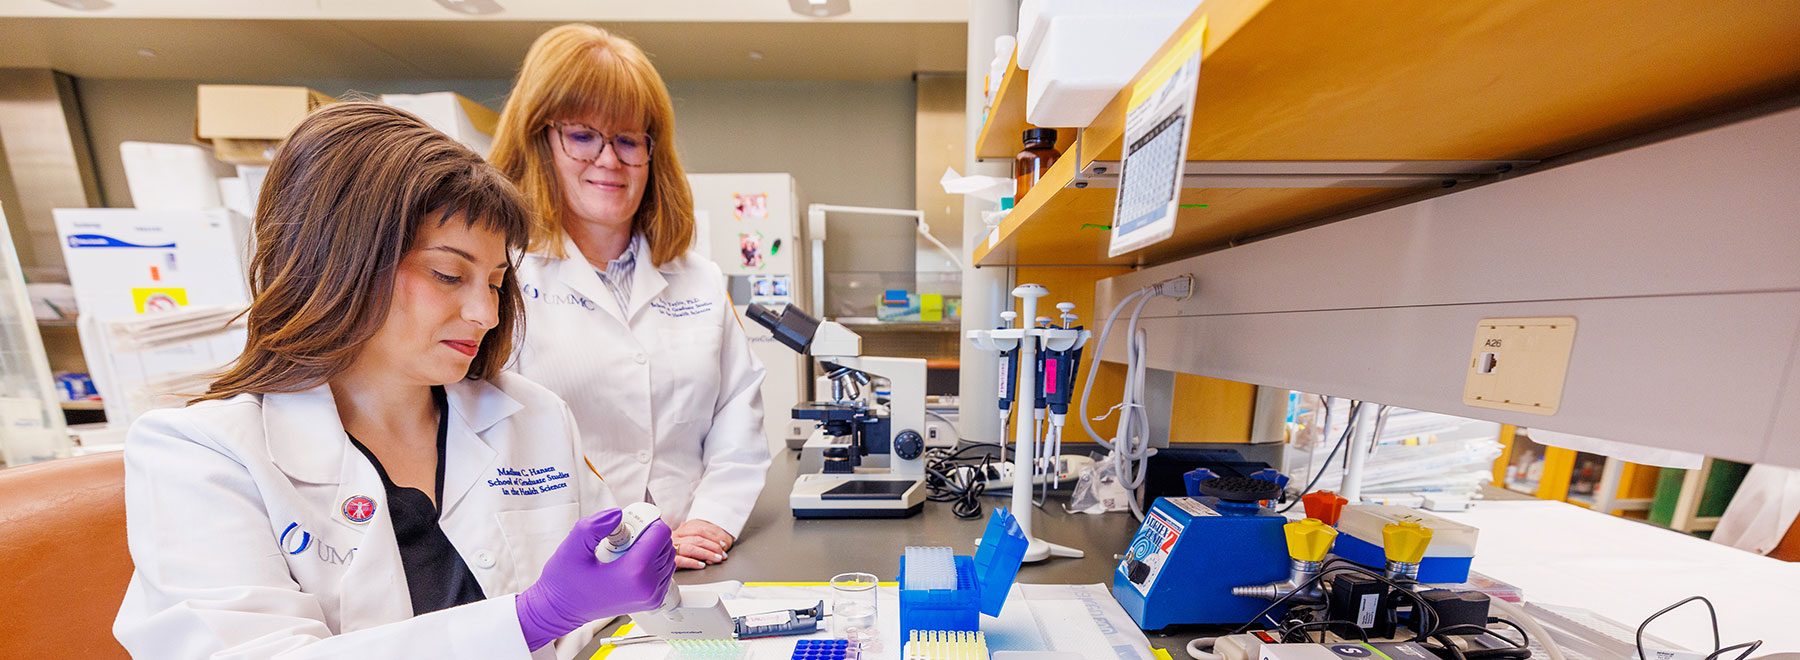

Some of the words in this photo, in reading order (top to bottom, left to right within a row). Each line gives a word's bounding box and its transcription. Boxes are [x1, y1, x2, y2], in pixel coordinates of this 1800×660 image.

[542, 292, 595, 311] UMMC
[1485, 339, 1502, 348] A26
[487, 477, 513, 487] School
[539, 482, 567, 493] Sciences
[1160, 530, 1179, 554] 2
